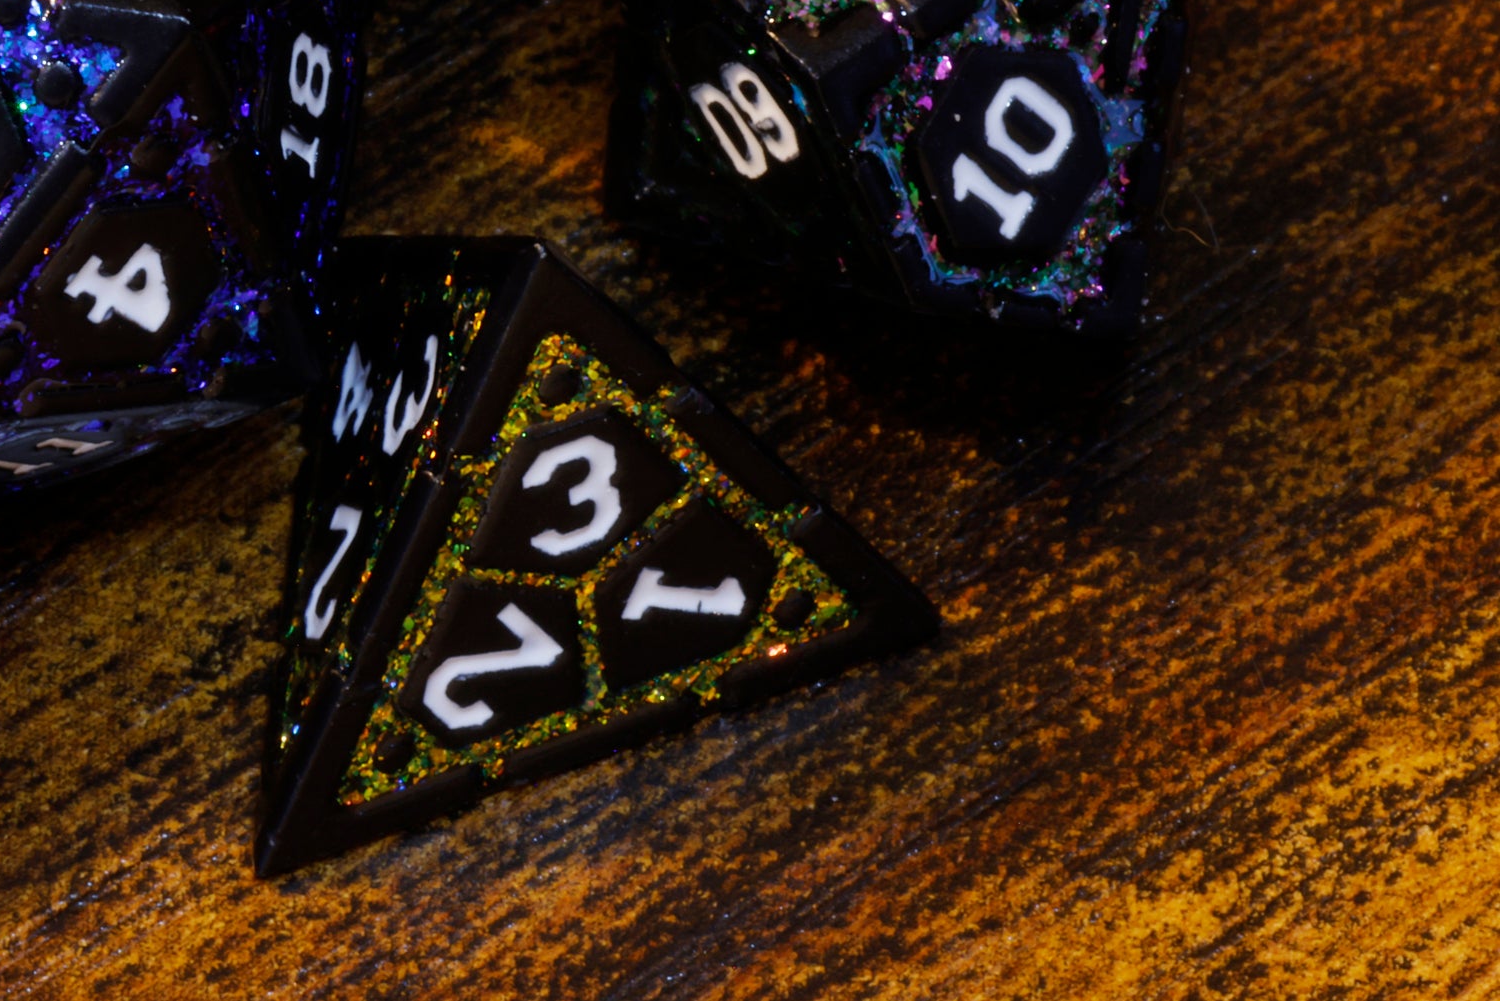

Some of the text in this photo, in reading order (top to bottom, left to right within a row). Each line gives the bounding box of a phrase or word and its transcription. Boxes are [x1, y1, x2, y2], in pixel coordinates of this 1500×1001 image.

[281, 34, 331, 177] 18
[953, 77, 1074, 239] 10
[65, 244, 170, 332] 4
[383, 335, 438, 455] 3
[523, 436, 621, 556] 3
[305, 506, 362, 639] 2
[622, 568, 745, 620] 1
[424, 604, 563, 729] 2
